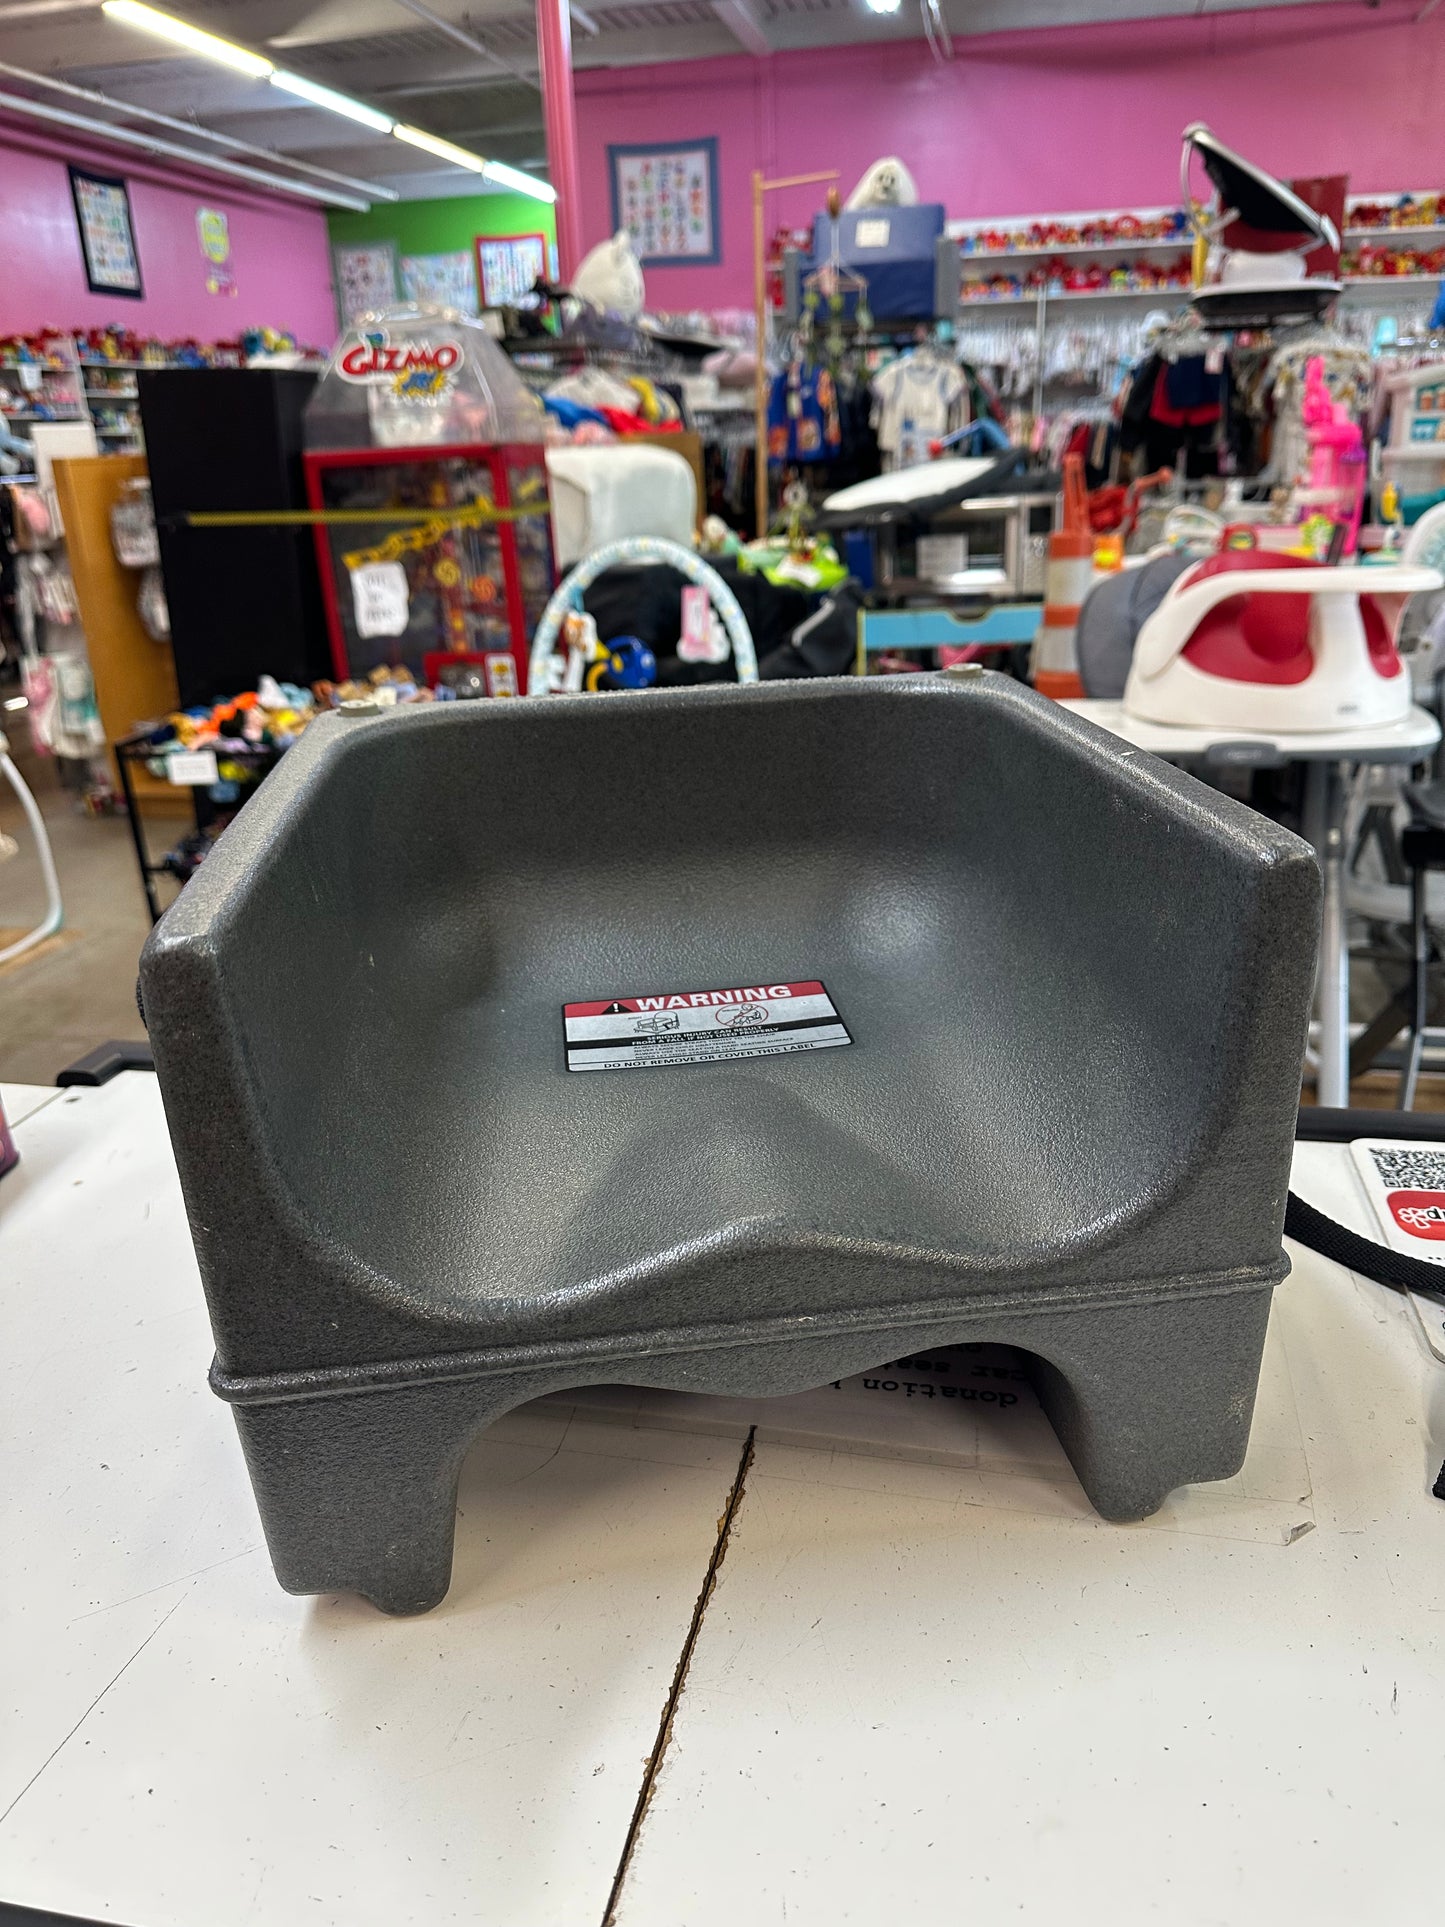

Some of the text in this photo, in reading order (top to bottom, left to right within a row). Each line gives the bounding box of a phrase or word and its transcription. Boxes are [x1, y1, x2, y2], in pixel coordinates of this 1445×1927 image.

[342, 346, 458, 375] GIZMO
[635, 985, 792, 1011] WARNING
[739, 1027, 779, 1035] PROPERLY
[650, 1056, 696, 1065] REMOVE
[718, 1051, 754, 1059] COVER
[783, 1043, 817, 1051] LABEL
[971, 1365, 1026, 1381] car
[863, 1378, 1018, 1408] donation
